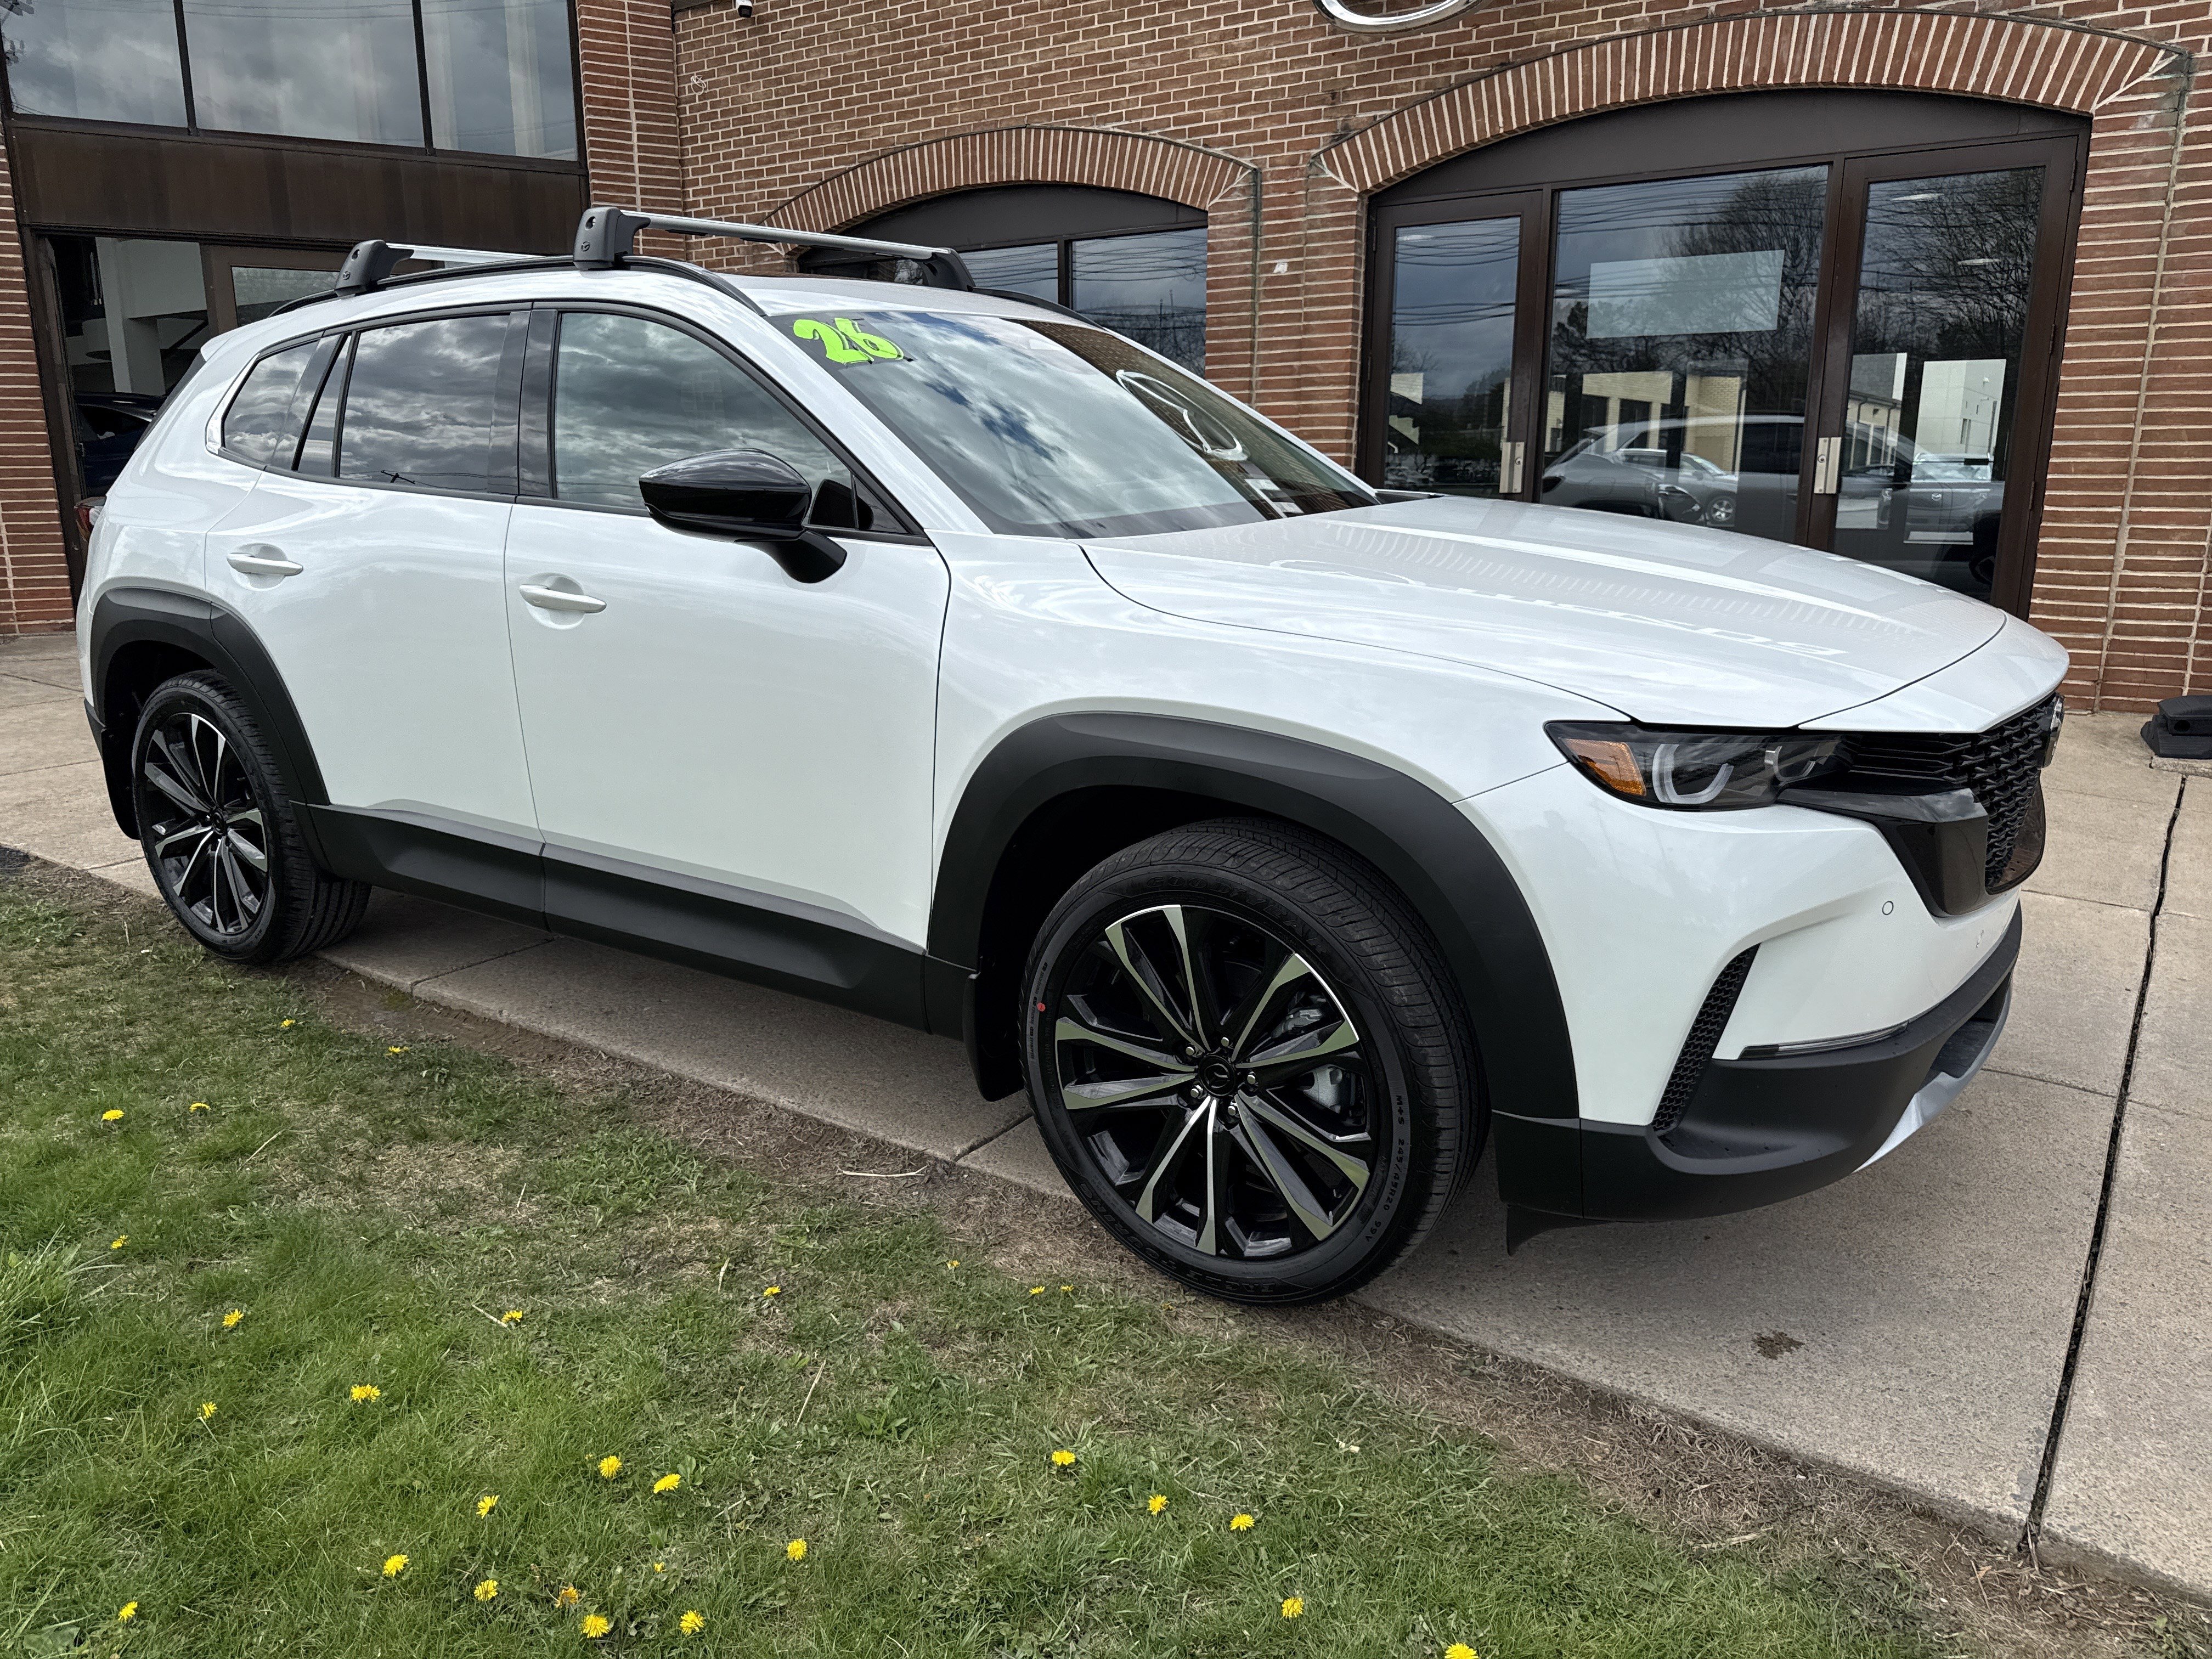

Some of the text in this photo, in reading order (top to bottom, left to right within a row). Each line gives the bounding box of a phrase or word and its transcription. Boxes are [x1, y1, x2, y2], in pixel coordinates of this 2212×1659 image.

[793, 317, 905, 364] 26
[1146, 876, 1328, 955] GOODYEAR
[1396, 1094, 1404, 1125] M+S
[1383, 1138, 1405, 1211] 245/45R20
[1080, 1183, 1177, 1269] TOURING
[1365, 1220, 1381, 1242] 99V
